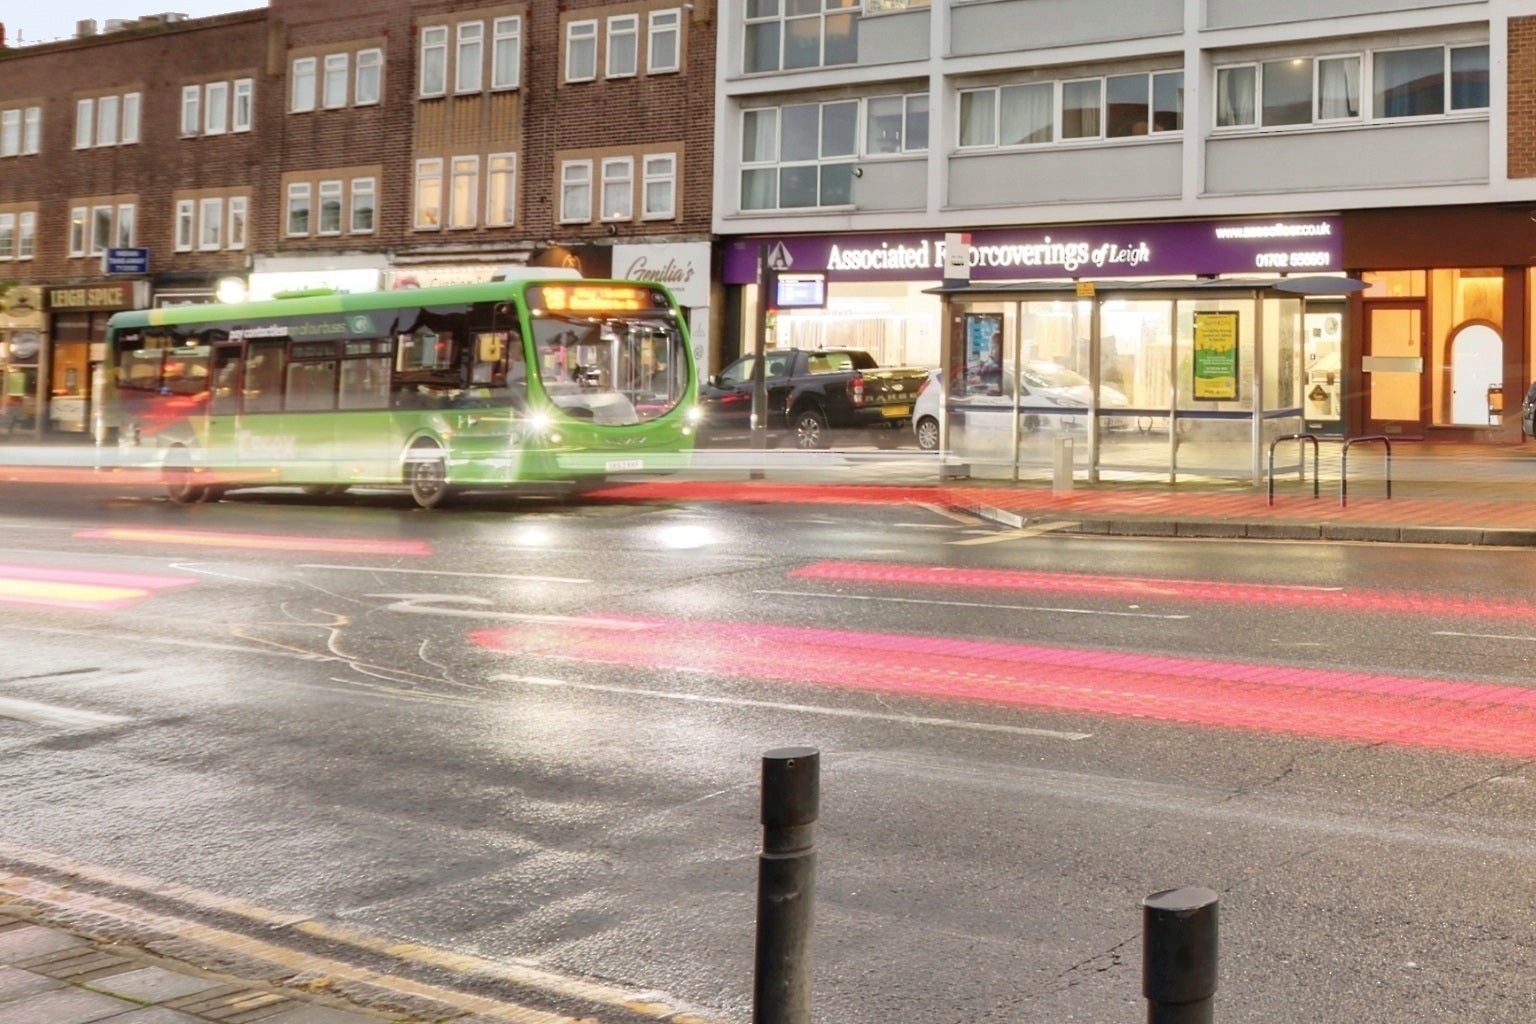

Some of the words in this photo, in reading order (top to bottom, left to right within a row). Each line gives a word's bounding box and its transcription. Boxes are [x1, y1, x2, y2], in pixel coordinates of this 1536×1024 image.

[827, 240, 930, 270] Associated
[934, 236, 1090, 271] Forcoverings
[1092, 243, 1109, 267] of
[1109, 242, 1150, 267] Leigh
[51, 289, 86, 307] LEIGH
[88, 287, 123, 306] SPICE
